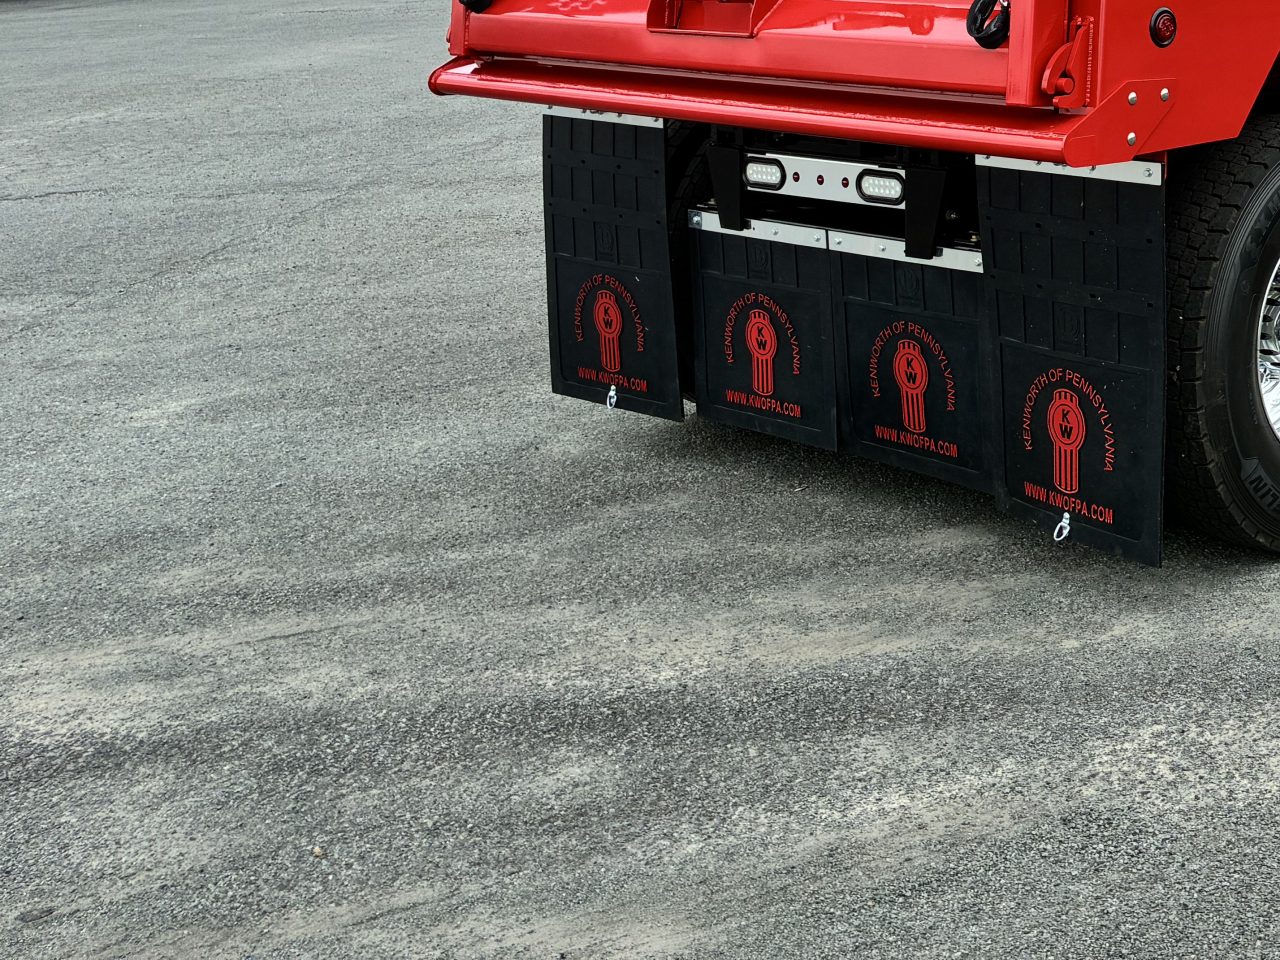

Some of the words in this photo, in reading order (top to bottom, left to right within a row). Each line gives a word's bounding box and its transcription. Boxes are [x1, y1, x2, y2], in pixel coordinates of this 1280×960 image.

[575, 279, 593, 342] KENWORTH
[593, 273, 603, 285] OF
[605, 275, 645, 352] PENNSYLVANIA
[724, 298, 745, 364] KENWORTH
[744, 292, 756, 304] OF
[758, 293, 800, 375] PENNSYLVANIA
[577, 366, 648, 393] WWW.KWOFPA.COM
[869, 326, 892, 397] KENWORTH
[892, 320, 905, 334] OF
[908, 322, 956, 411] PENNSYLVANIA
[726, 389, 801, 418] WWW.KWOFPA.COM
[1022, 372, 1048, 450] KENWORTH
[1048, 368, 1063, 382] OF
[1065, 369, 1115, 471] PENNSYLVANIA
[874, 424, 958, 458] WWW.KWOFPA.COM
[1024, 480, 1113, 524] WWW.KWOFPA.COM
